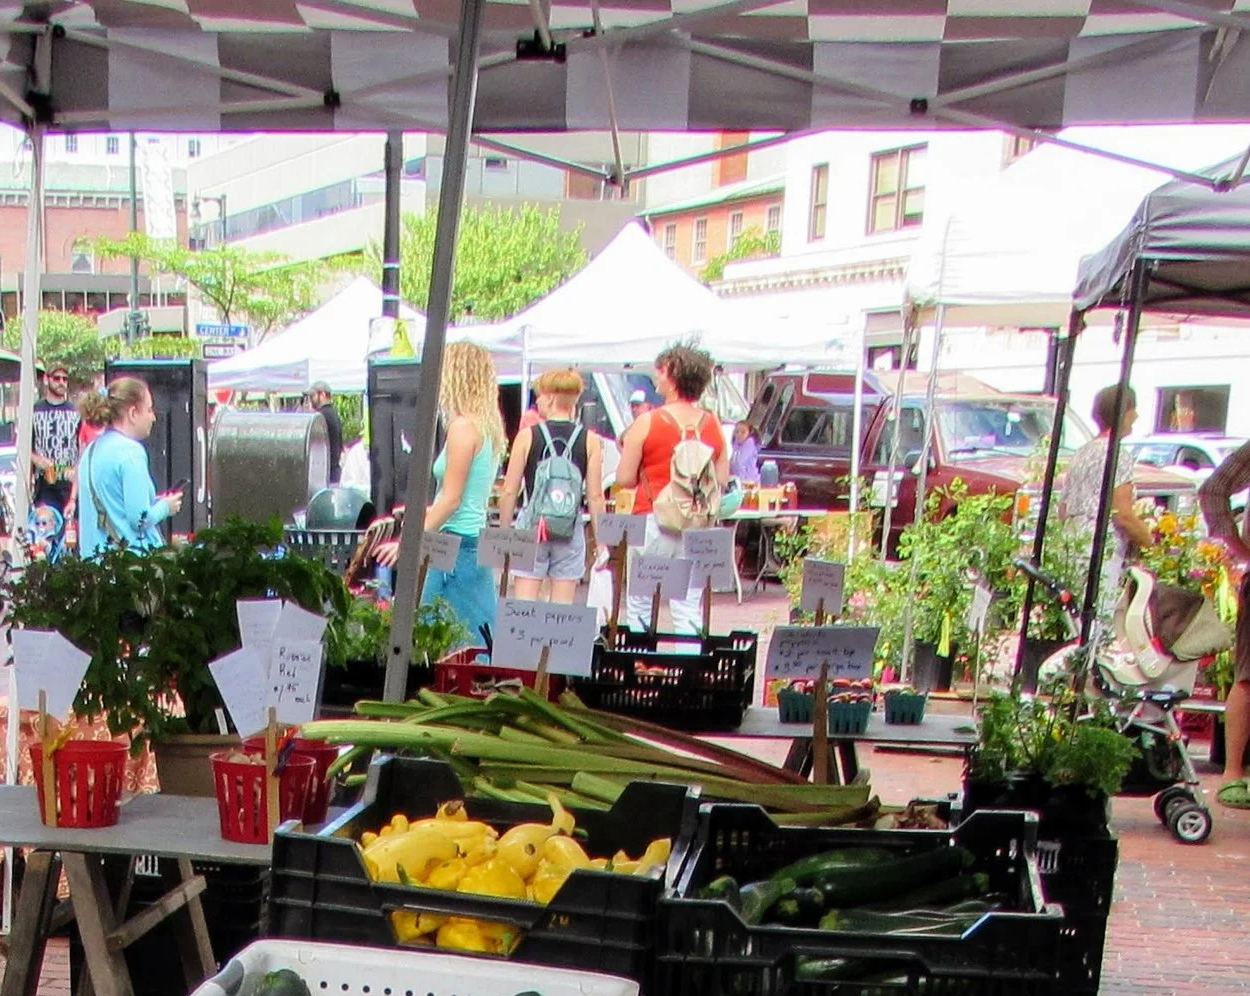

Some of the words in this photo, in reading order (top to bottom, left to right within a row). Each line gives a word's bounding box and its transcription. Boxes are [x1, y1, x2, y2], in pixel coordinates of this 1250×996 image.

[199, 326, 229, 336] CENTER
[505, 602, 536, 618] Sweet
[544, 612, 583, 624] peppers
[510, 627, 526, 641] $3
[530, 636, 544, 647] per
[549, 636, 575, 648] pound
